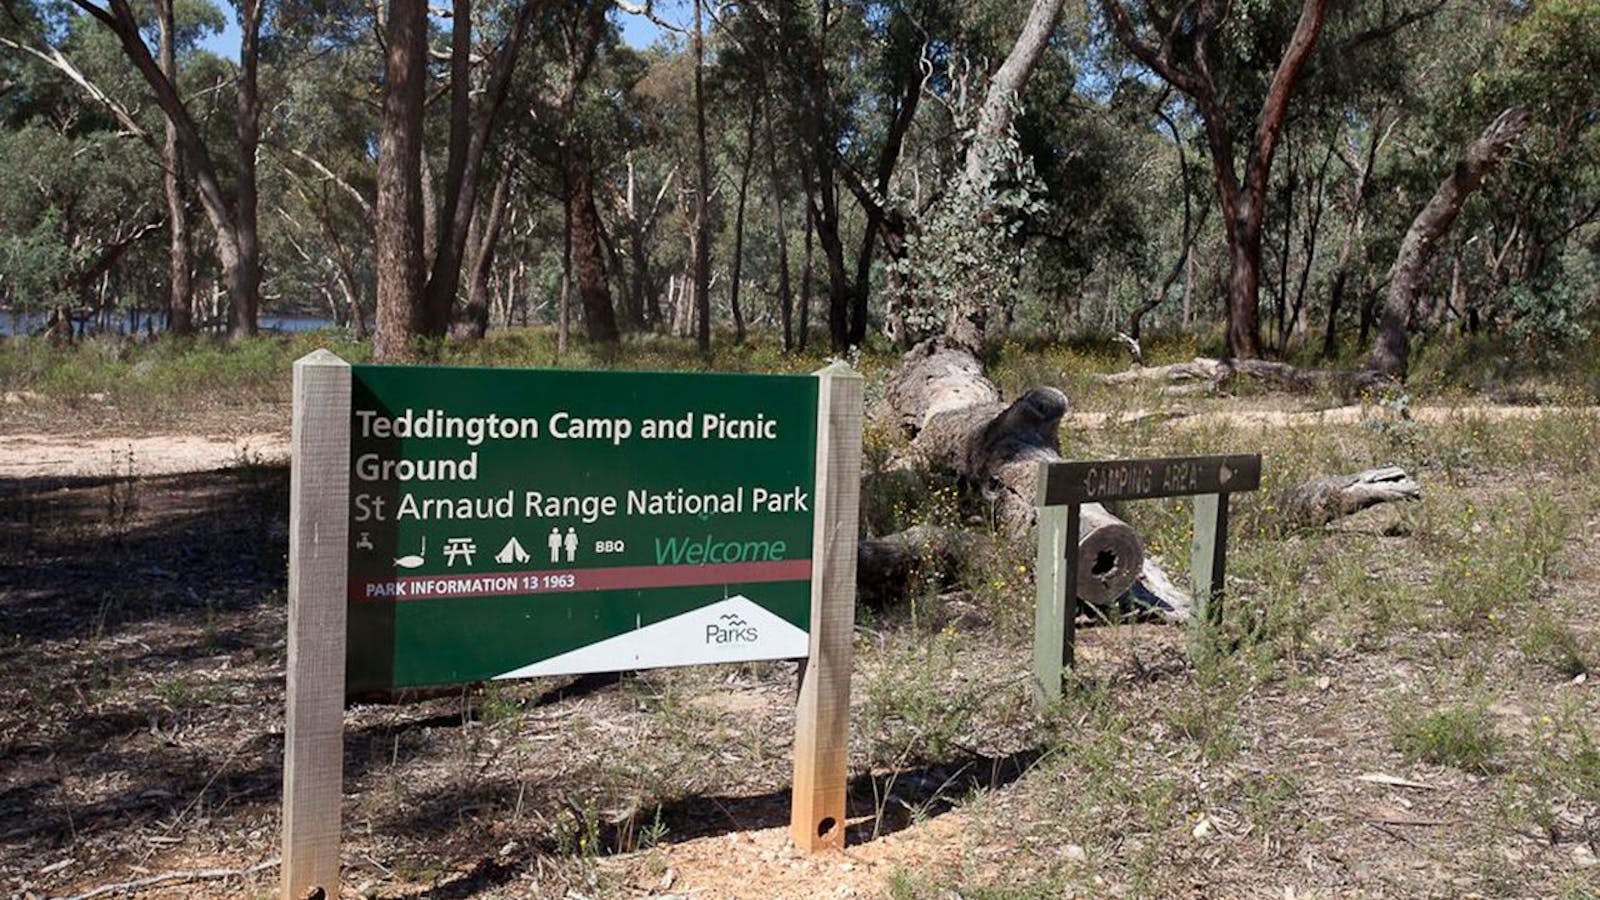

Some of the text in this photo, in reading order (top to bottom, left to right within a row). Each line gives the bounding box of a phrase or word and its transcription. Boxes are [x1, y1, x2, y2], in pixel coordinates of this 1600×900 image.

[355, 409, 777, 445] Teddington Camp and Picnic
[355, 452, 479, 481] Ground
[1085, 467, 1150, 497] CAMPING
[354, 486, 808, 522] St Arnaud Range National Park
[595, 540, 625, 554] BBQ
[654, 535, 786, 565] Welcome
[366, 574, 575, 598] PARK INFORMATION 13 1963
[706, 624, 758, 644] Parks
